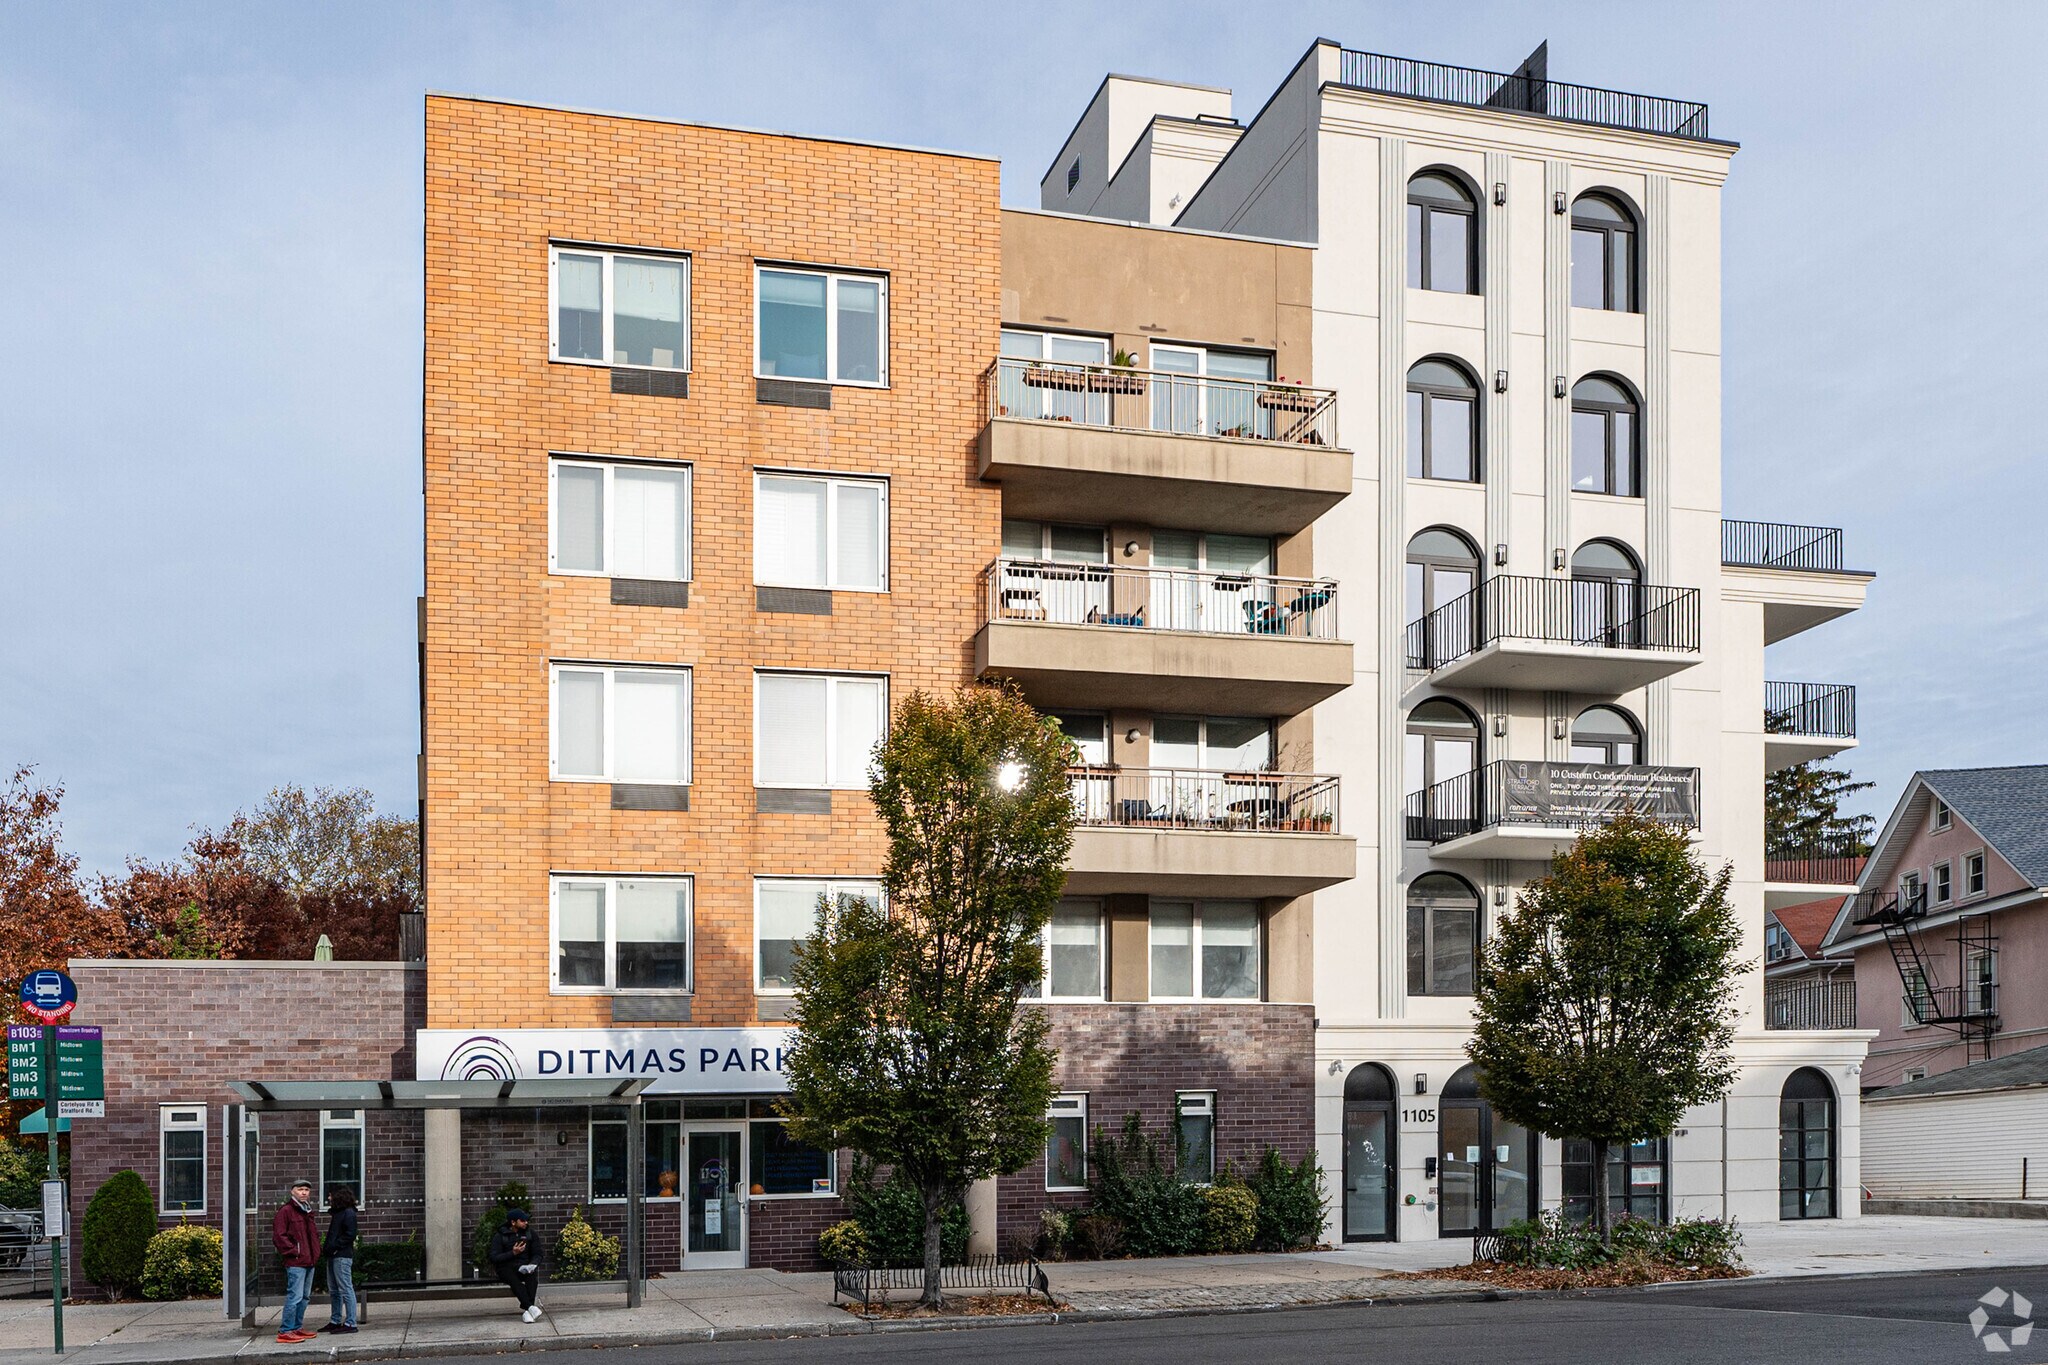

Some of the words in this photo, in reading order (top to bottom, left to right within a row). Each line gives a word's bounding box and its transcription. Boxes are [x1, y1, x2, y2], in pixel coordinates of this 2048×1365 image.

[1550, 769, 1559, 779] 10
[1561, 769, 1591, 780] Custom
[1592, 770, 1649, 782] Condominium
[1650, 772, 1692, 784] Residences
[26, 1004, 37, 1014] NO
[37, 1004, 73, 1018] STANDING
[11, 1027, 37, 1039] B103
[81, 1027, 99, 1035] Brooklyn
[11, 1042, 36, 1053] BM1
[12, 1056, 38, 1068] BM2
[538, 1047, 686, 1074] DITMAS
[700, 1047, 796, 1073] PARK
[12, 1071, 38, 1082] BM3
[12, 1086, 38, 1097] BM4
[60, 1101, 87, 1109] Cortelyou
[1402, 1109, 1436, 1123] 1105
